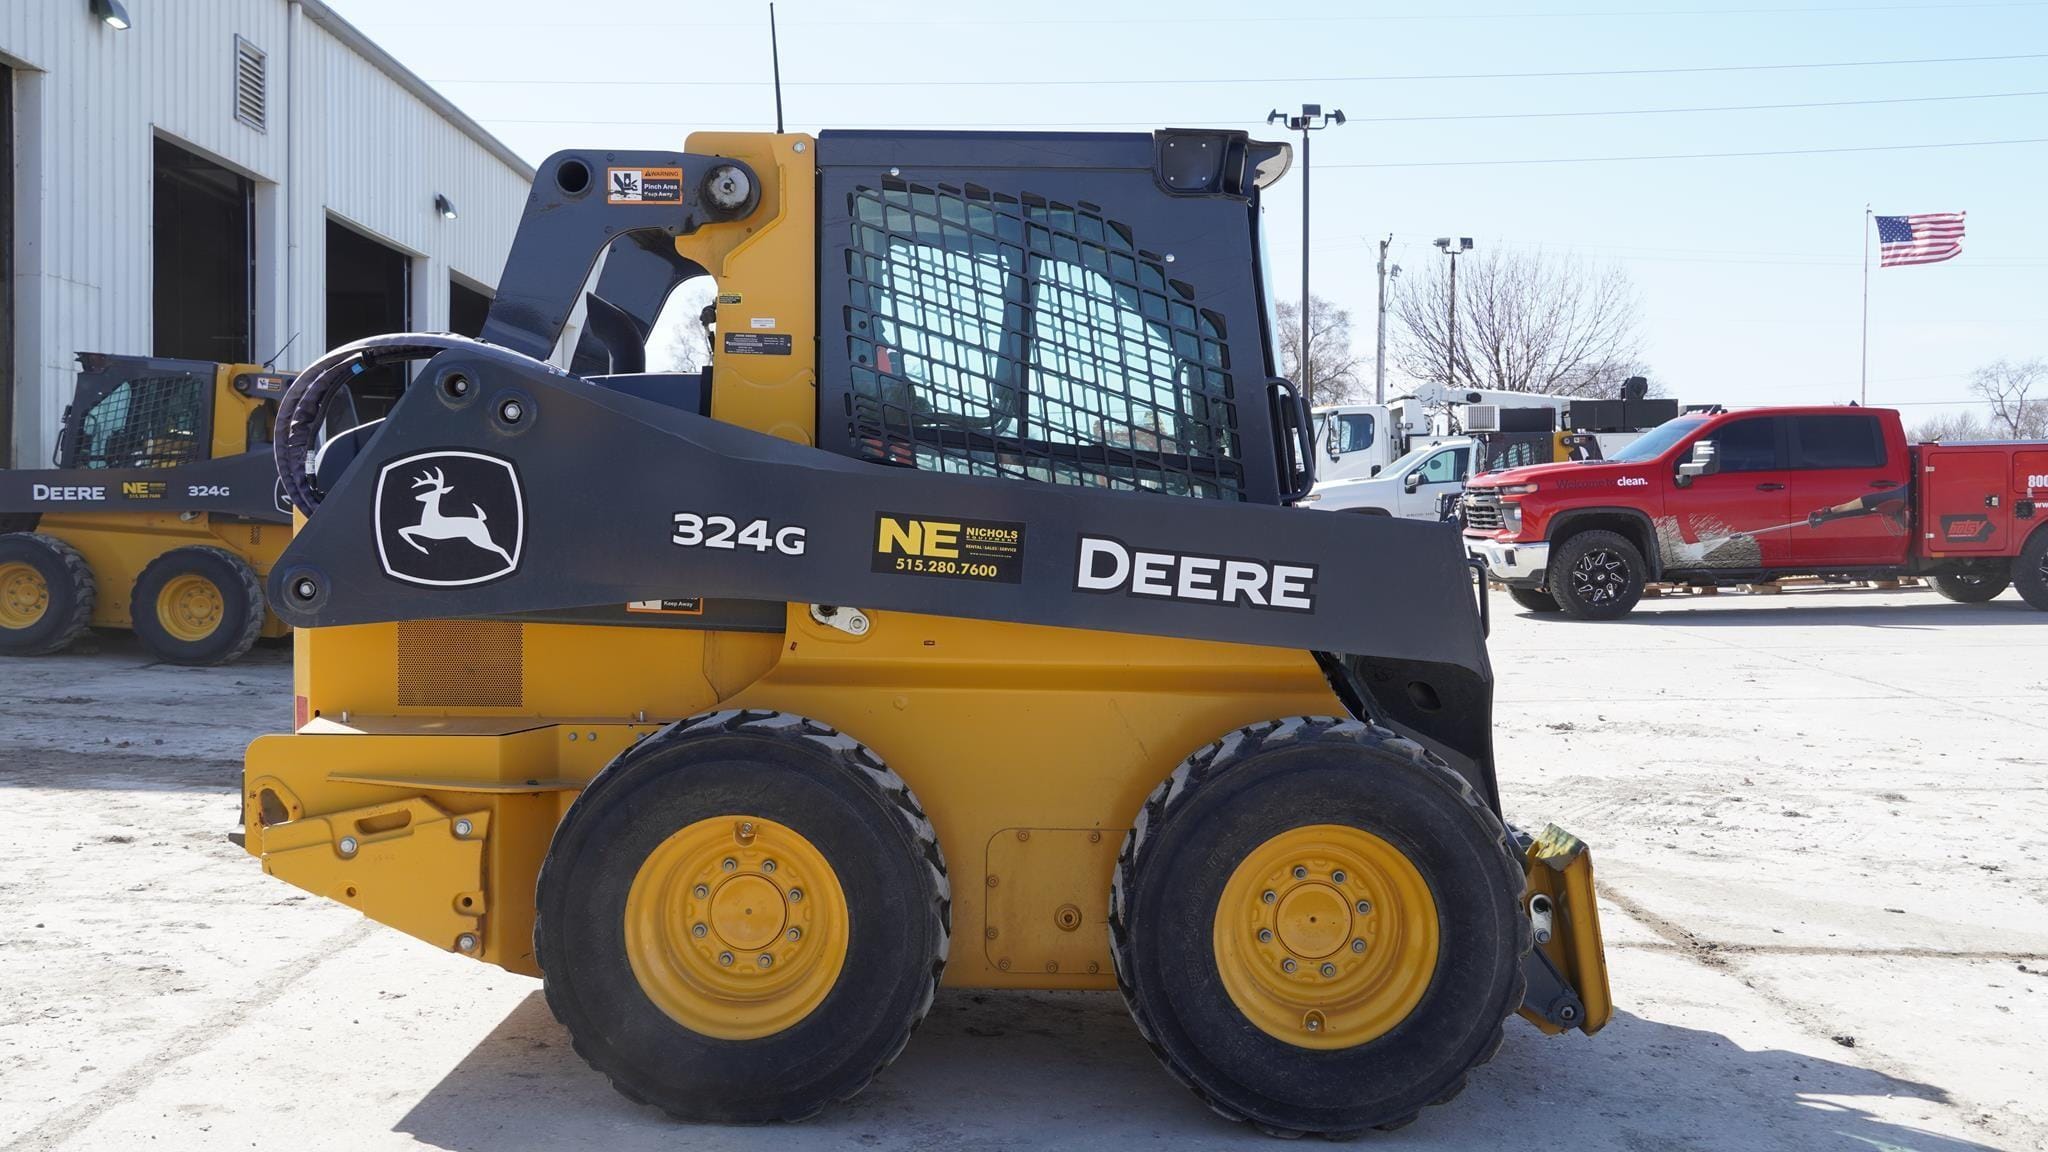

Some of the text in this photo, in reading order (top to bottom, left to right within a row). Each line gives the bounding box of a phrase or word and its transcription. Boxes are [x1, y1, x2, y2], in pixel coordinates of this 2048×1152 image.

[122, 482, 149, 494] NE
[1617, 475, 1649, 487] clean.
[33, 483, 106, 501] DEERE
[188, 485, 230, 497] 324G
[673, 513, 806, 555] 324G
[878, 517, 961, 559] NE
[966, 527, 1018, 539] NICHOLS
[896, 558, 997, 577] 515.280.7600
[1077, 537, 1314, 609] DEERE
